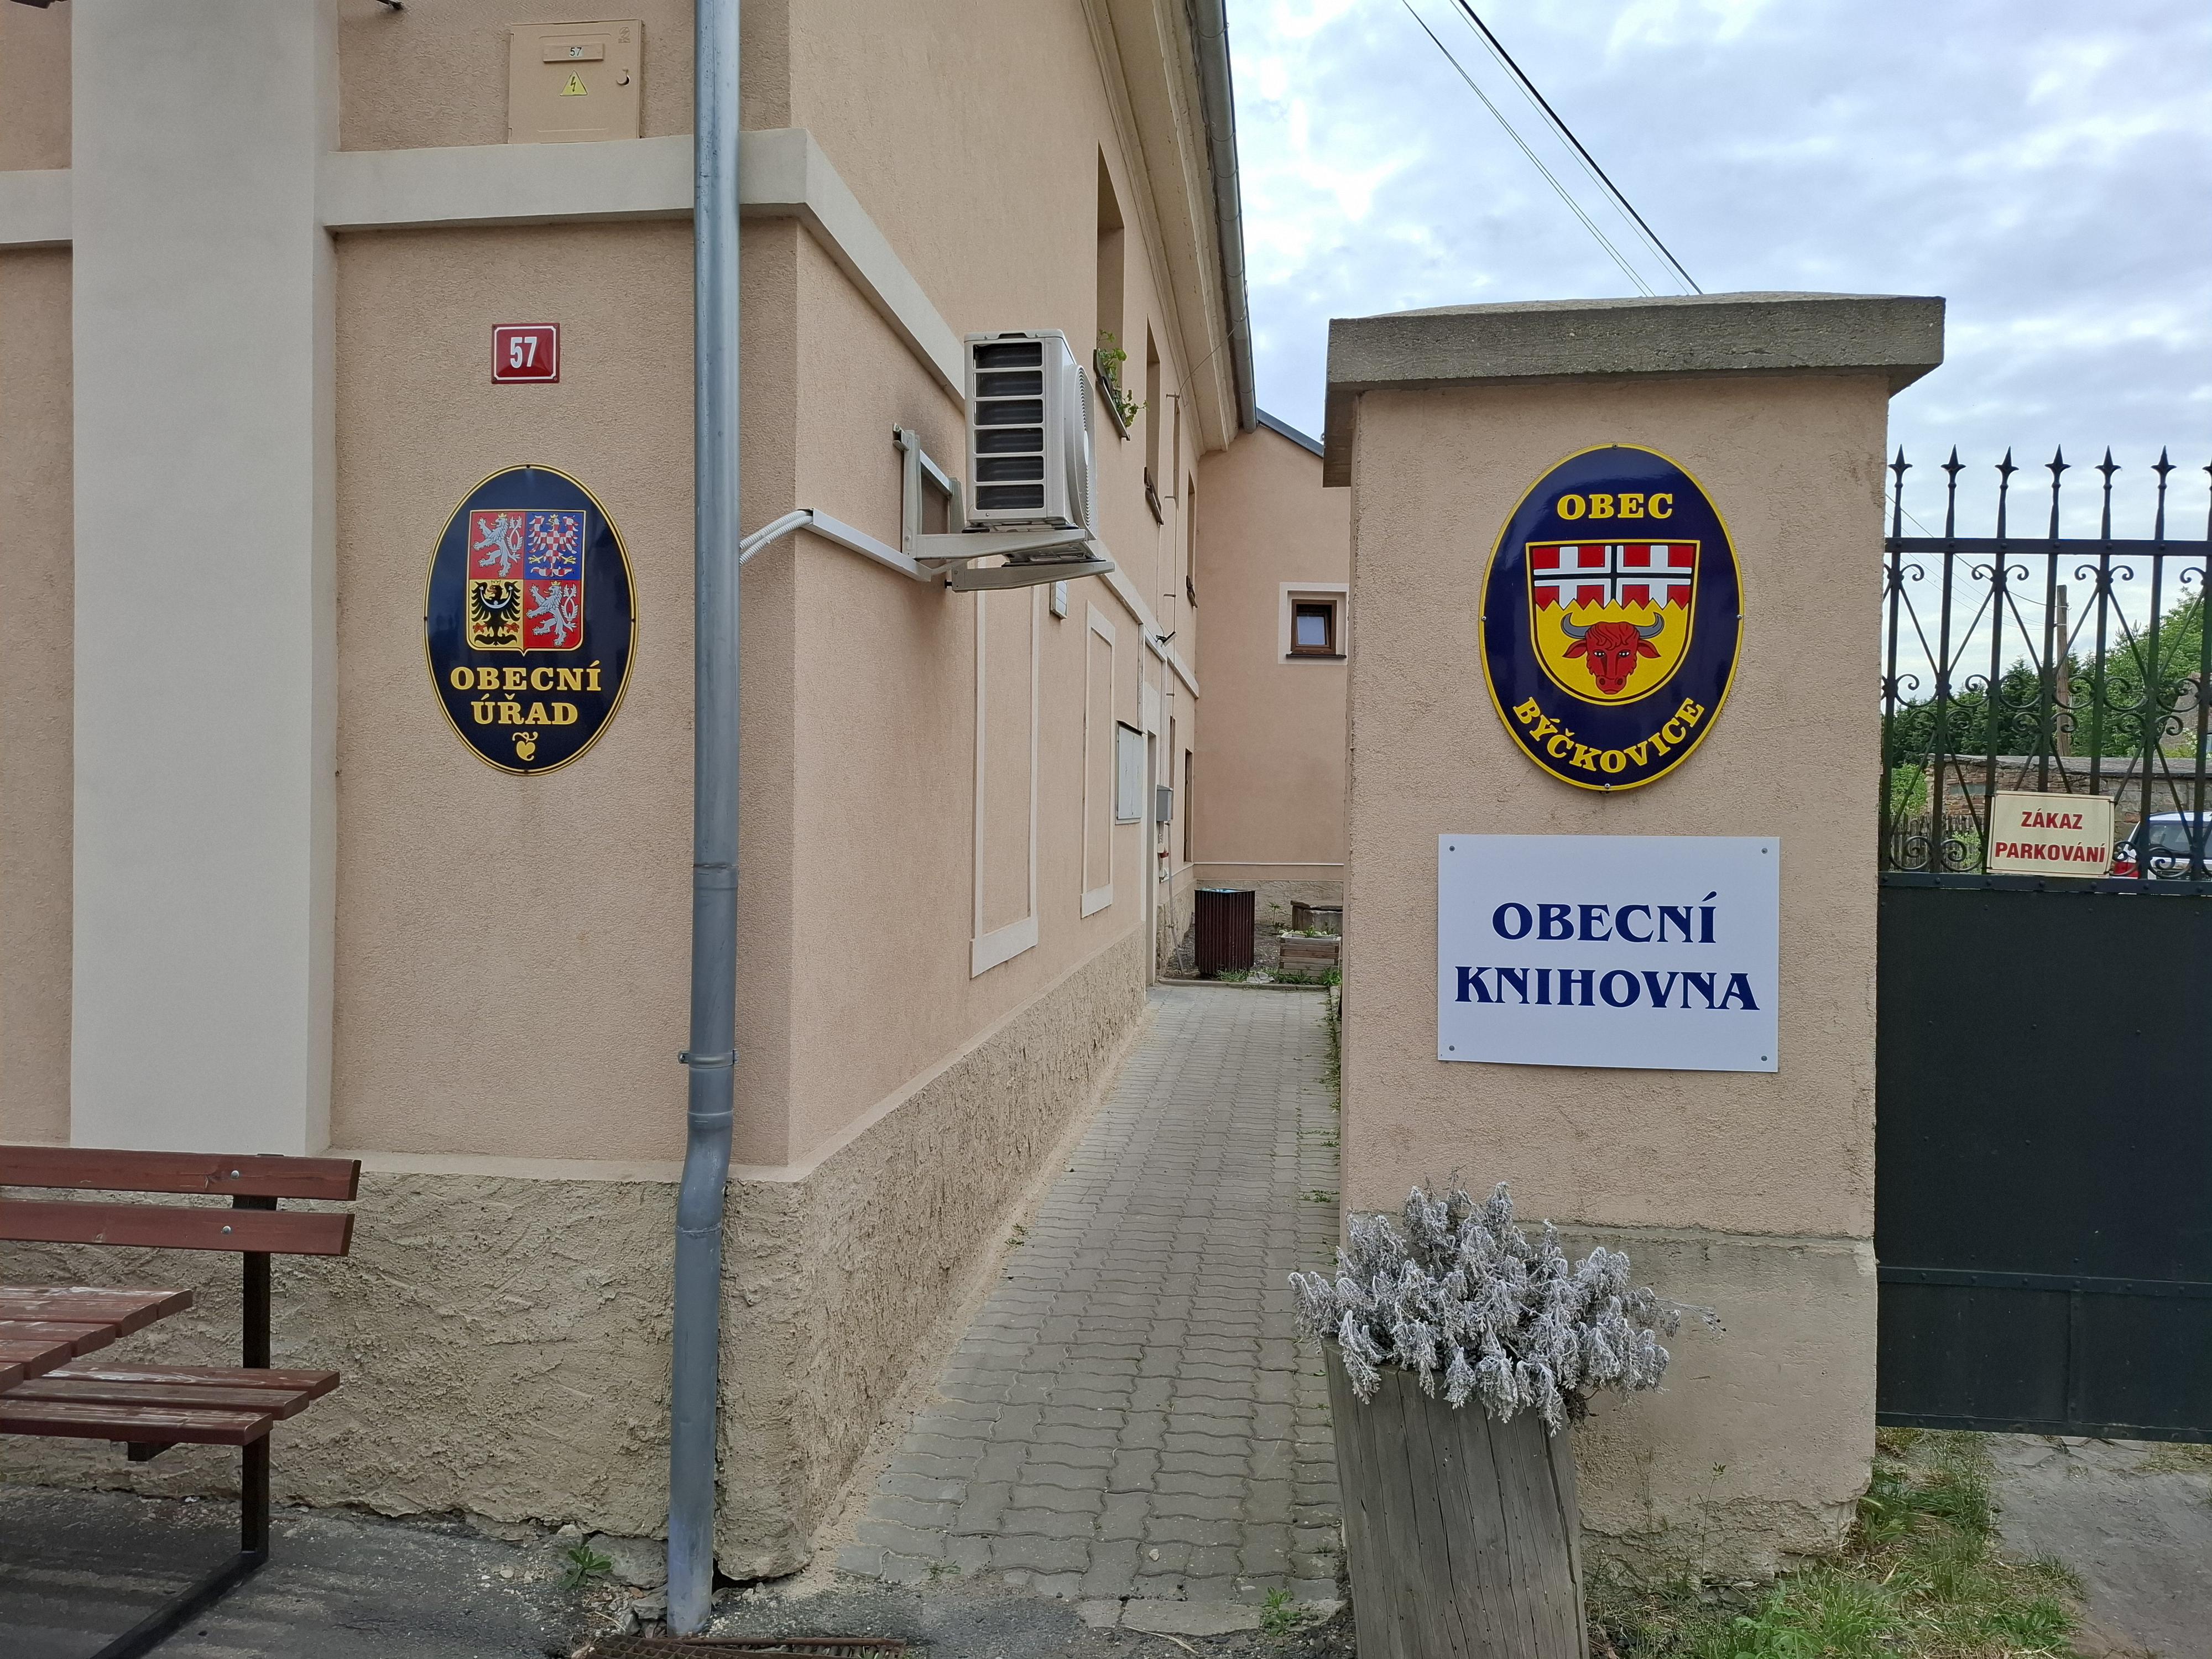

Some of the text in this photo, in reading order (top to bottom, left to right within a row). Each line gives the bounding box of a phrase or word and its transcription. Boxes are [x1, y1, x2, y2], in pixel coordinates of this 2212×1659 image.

[570, 47, 582, 56] 57
[510, 336, 537, 368] 57
[1557, 493, 1673, 519] OBEC
[451, 660, 602, 691] OBECNÍ
[471, 693, 578, 725] ÚŘAD
[1512, 696, 1705, 773] BÝČKOVICE
[2020, 808, 2083, 830] ZÁKAZ
[1994, 841, 2106, 863] PARKOVÁNÍ
[1492, 891, 1718, 943] OBECNÍ
[1455, 966, 1761, 1011] KNIHOVNA
